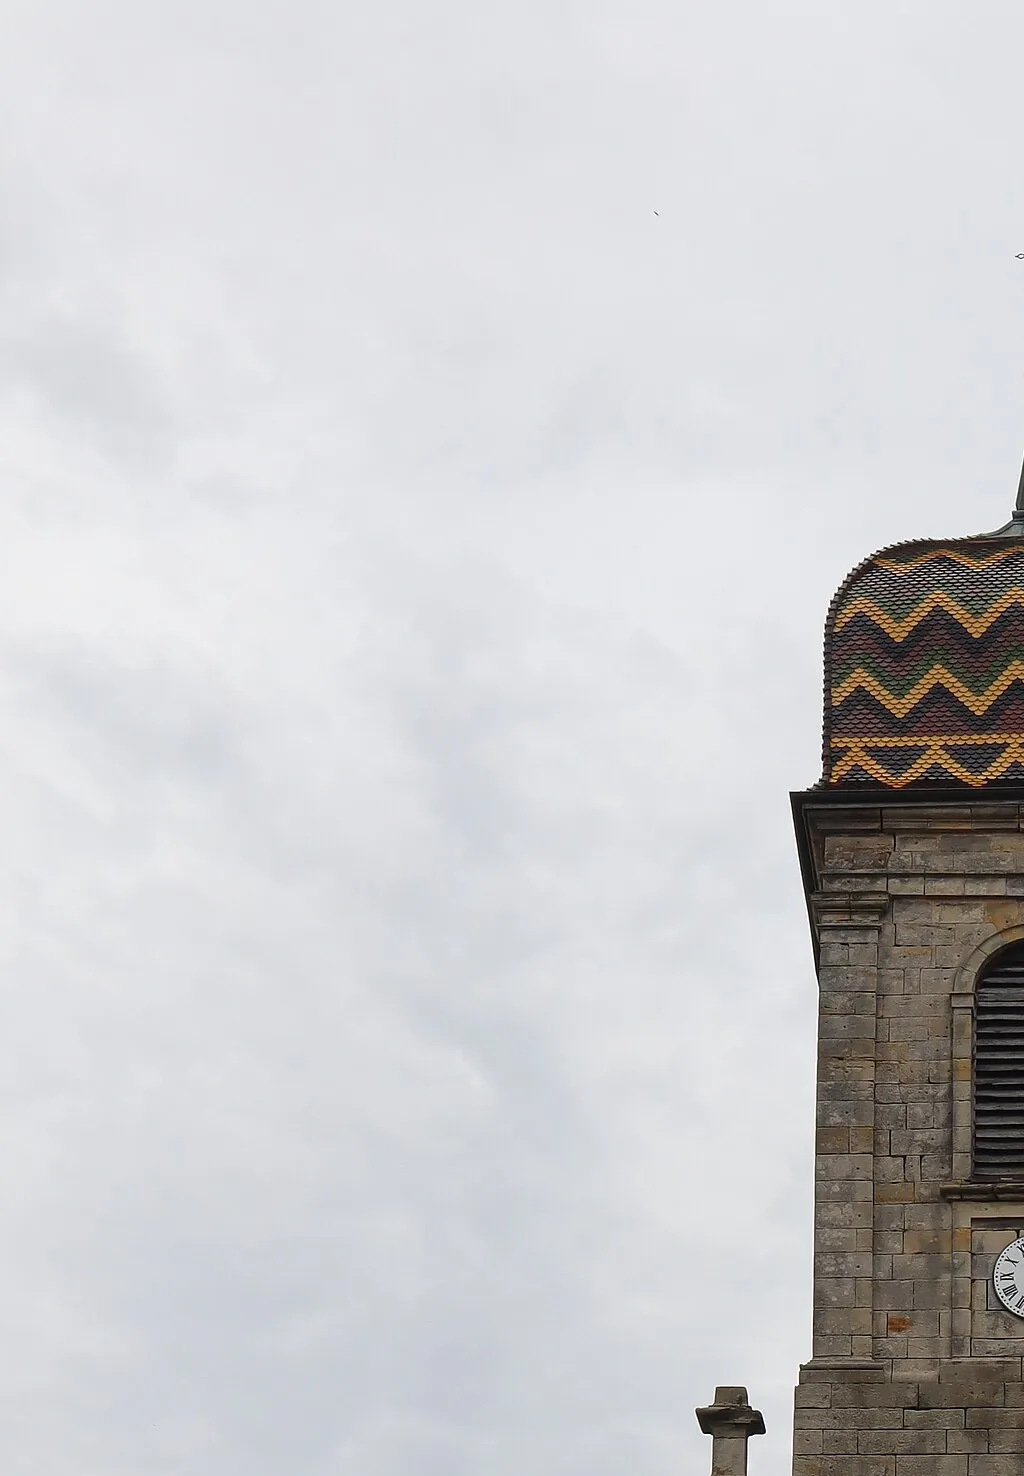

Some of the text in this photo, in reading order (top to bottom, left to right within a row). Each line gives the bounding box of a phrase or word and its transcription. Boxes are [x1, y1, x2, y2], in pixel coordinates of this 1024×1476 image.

[1004, 1256, 1019, 1267] X
[1000, 1272, 1014, 1280] IX
[1002, 1284, 1018, 1301] VIII
